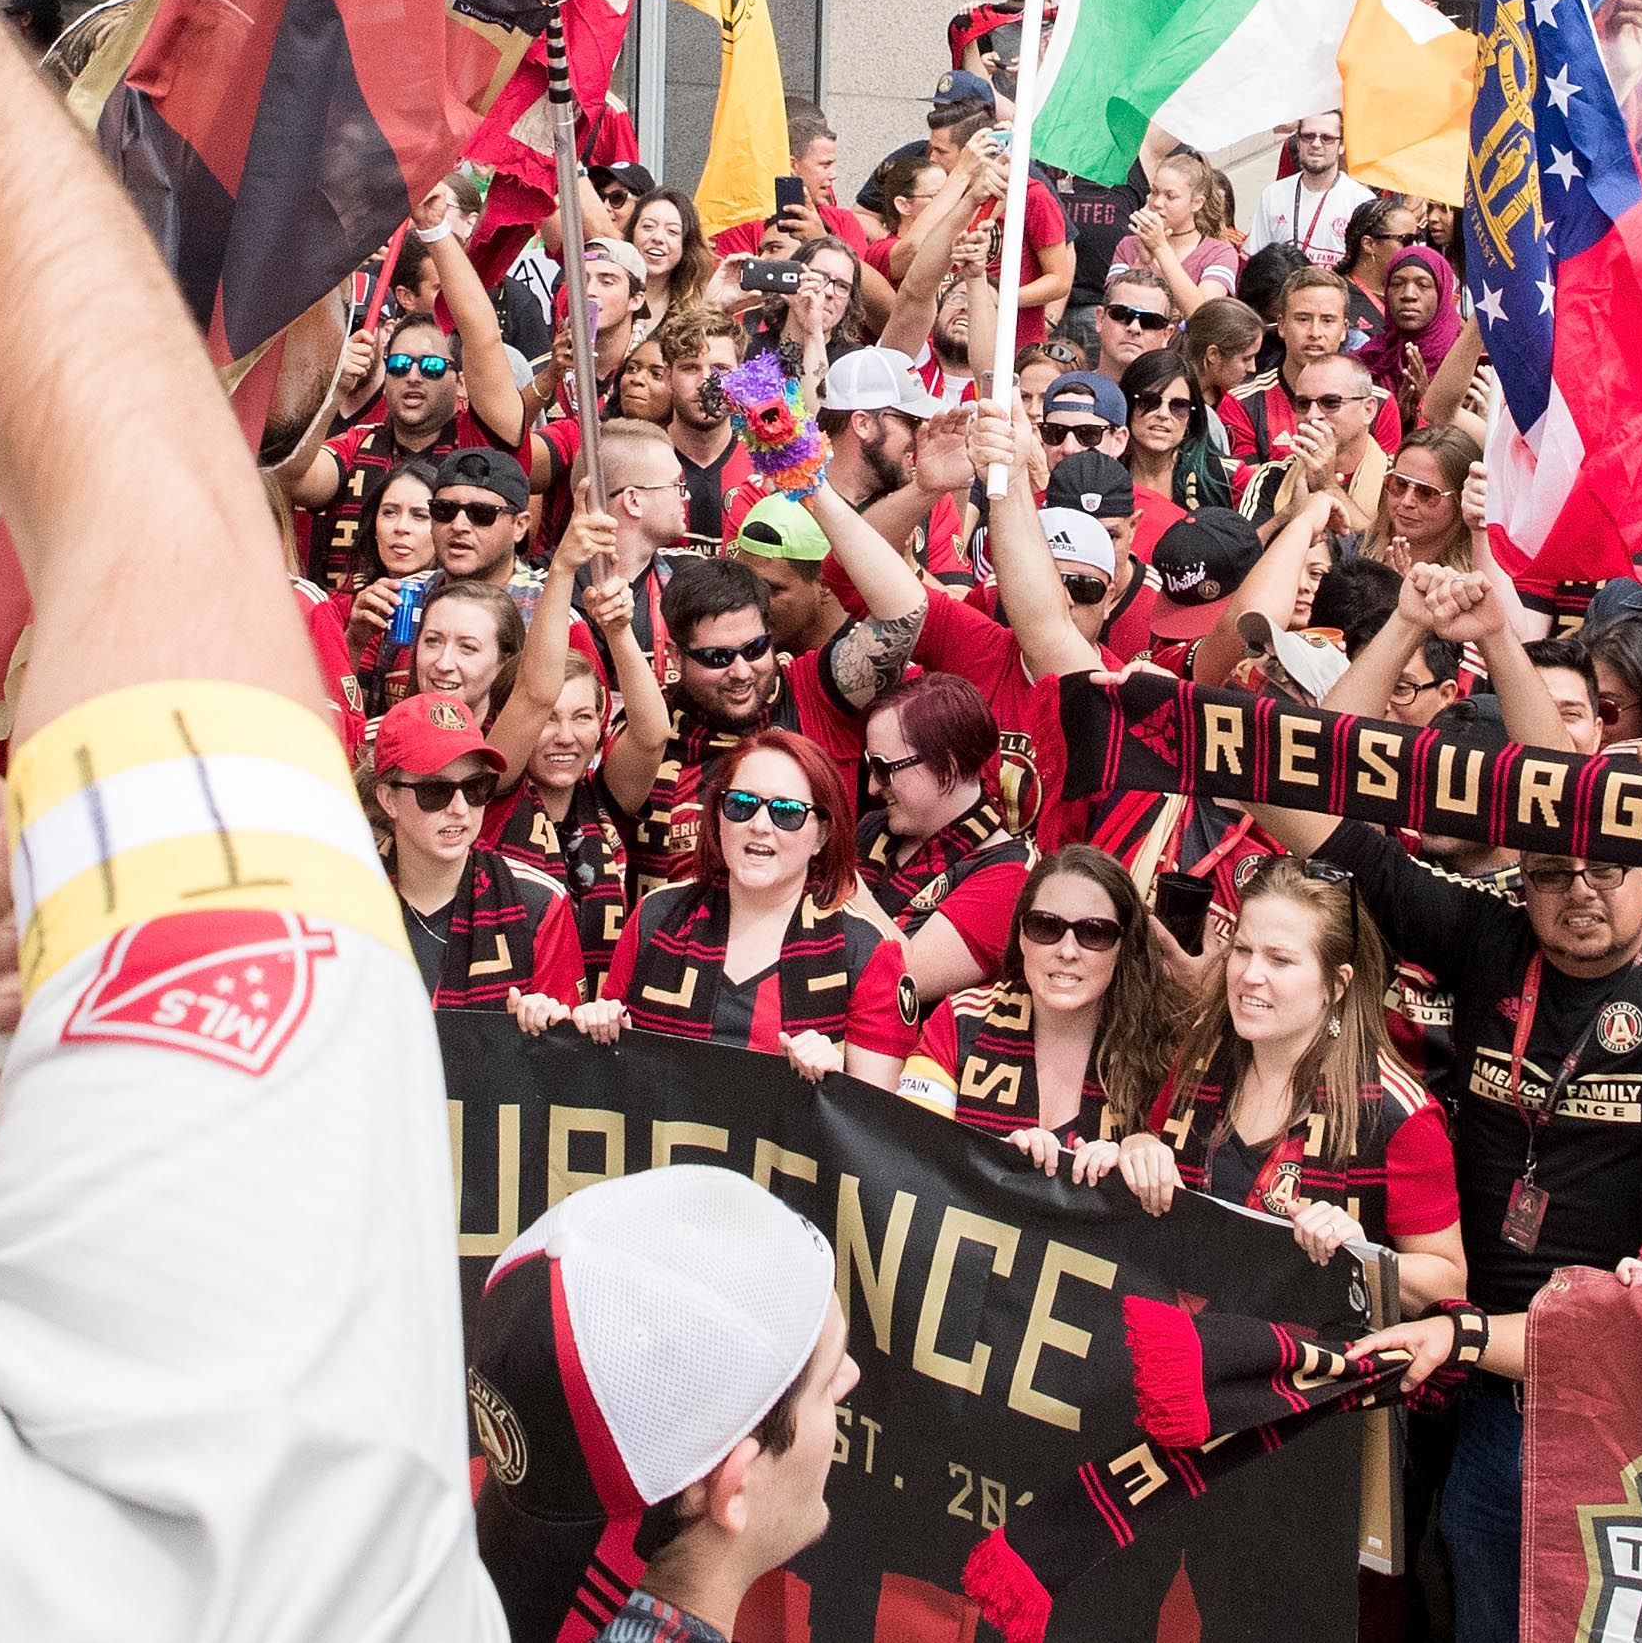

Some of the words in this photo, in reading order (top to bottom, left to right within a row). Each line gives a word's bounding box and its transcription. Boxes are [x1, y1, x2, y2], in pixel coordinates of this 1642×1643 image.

[1502, 72, 1534, 125] JUSTIC
[1166, 564, 1207, 594] United
[151, 988, 268, 1050] MLS
[1603, 1003, 1638, 1018] ATLANTA
[1603, 1036, 1631, 1052] UNITED
[1566, 1079, 1641, 1103] FAMILY
